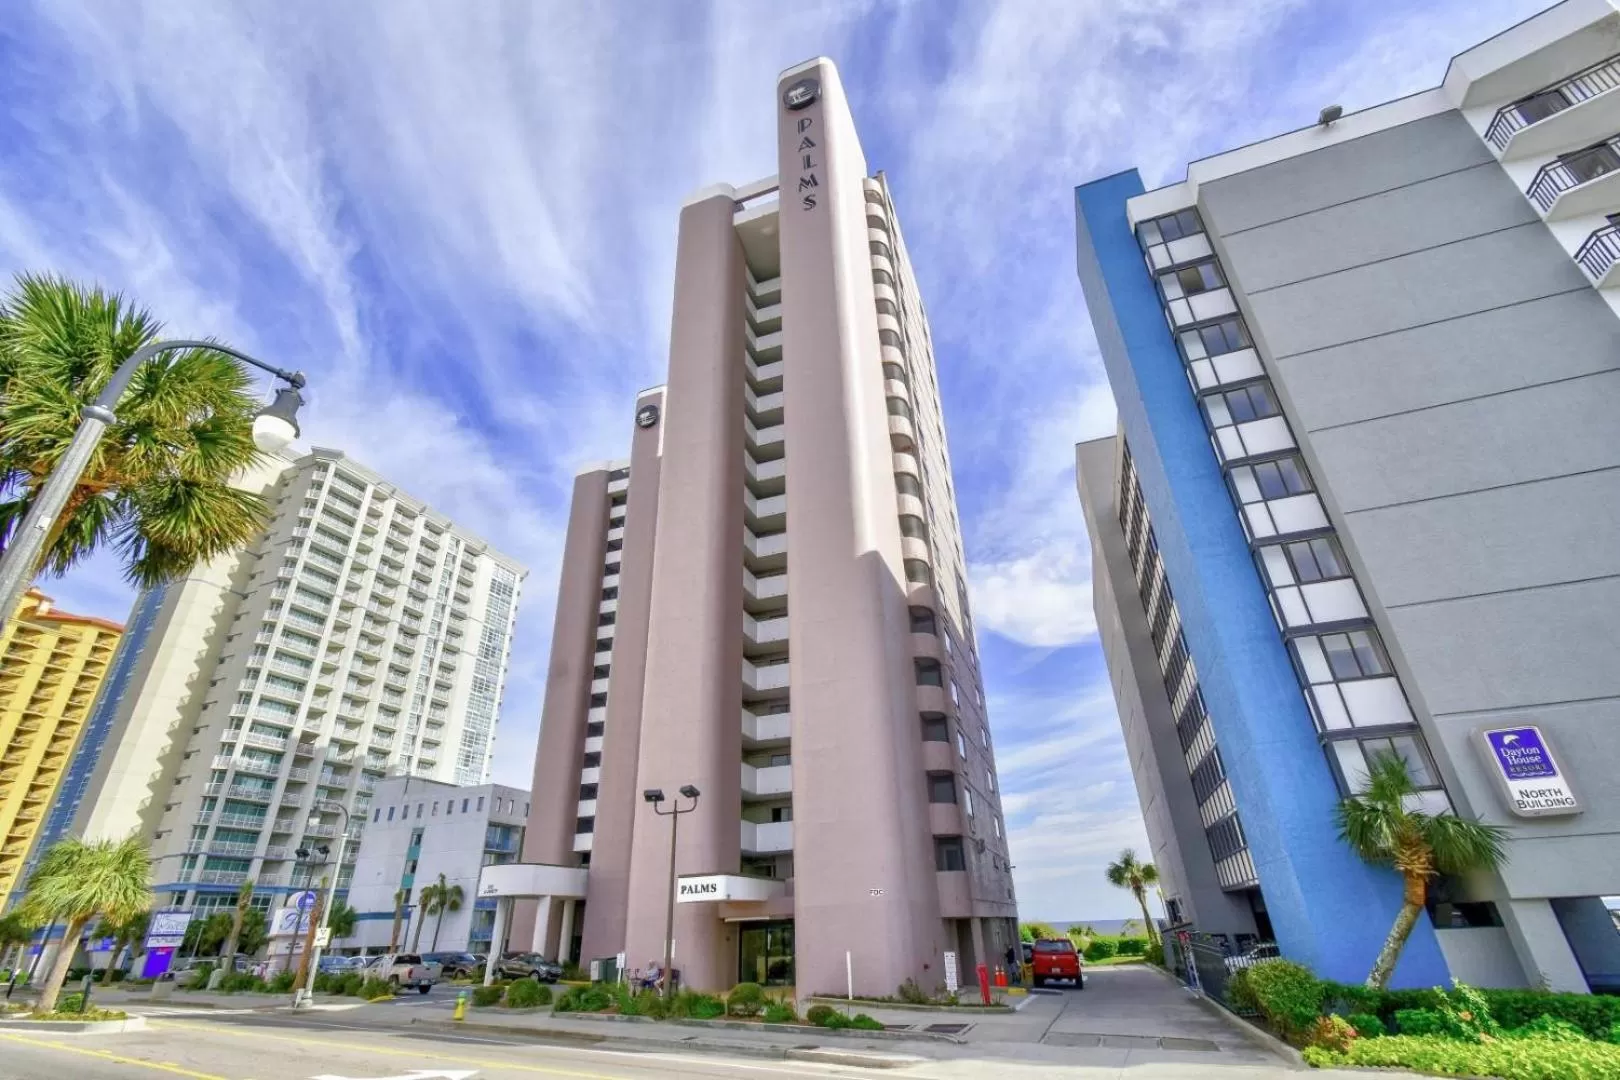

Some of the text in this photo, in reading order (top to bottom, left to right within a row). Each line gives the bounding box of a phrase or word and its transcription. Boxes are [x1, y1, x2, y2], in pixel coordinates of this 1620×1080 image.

[797, 117, 819, 211] PALMS
[1500, 747, 1540, 758] Dayton
[1506, 755, 1542, 765] House
[1518, 788, 1563, 799] NORTH
[1516, 797, 1575, 809] BUILDING
[680, 883, 717, 894] PALMS
